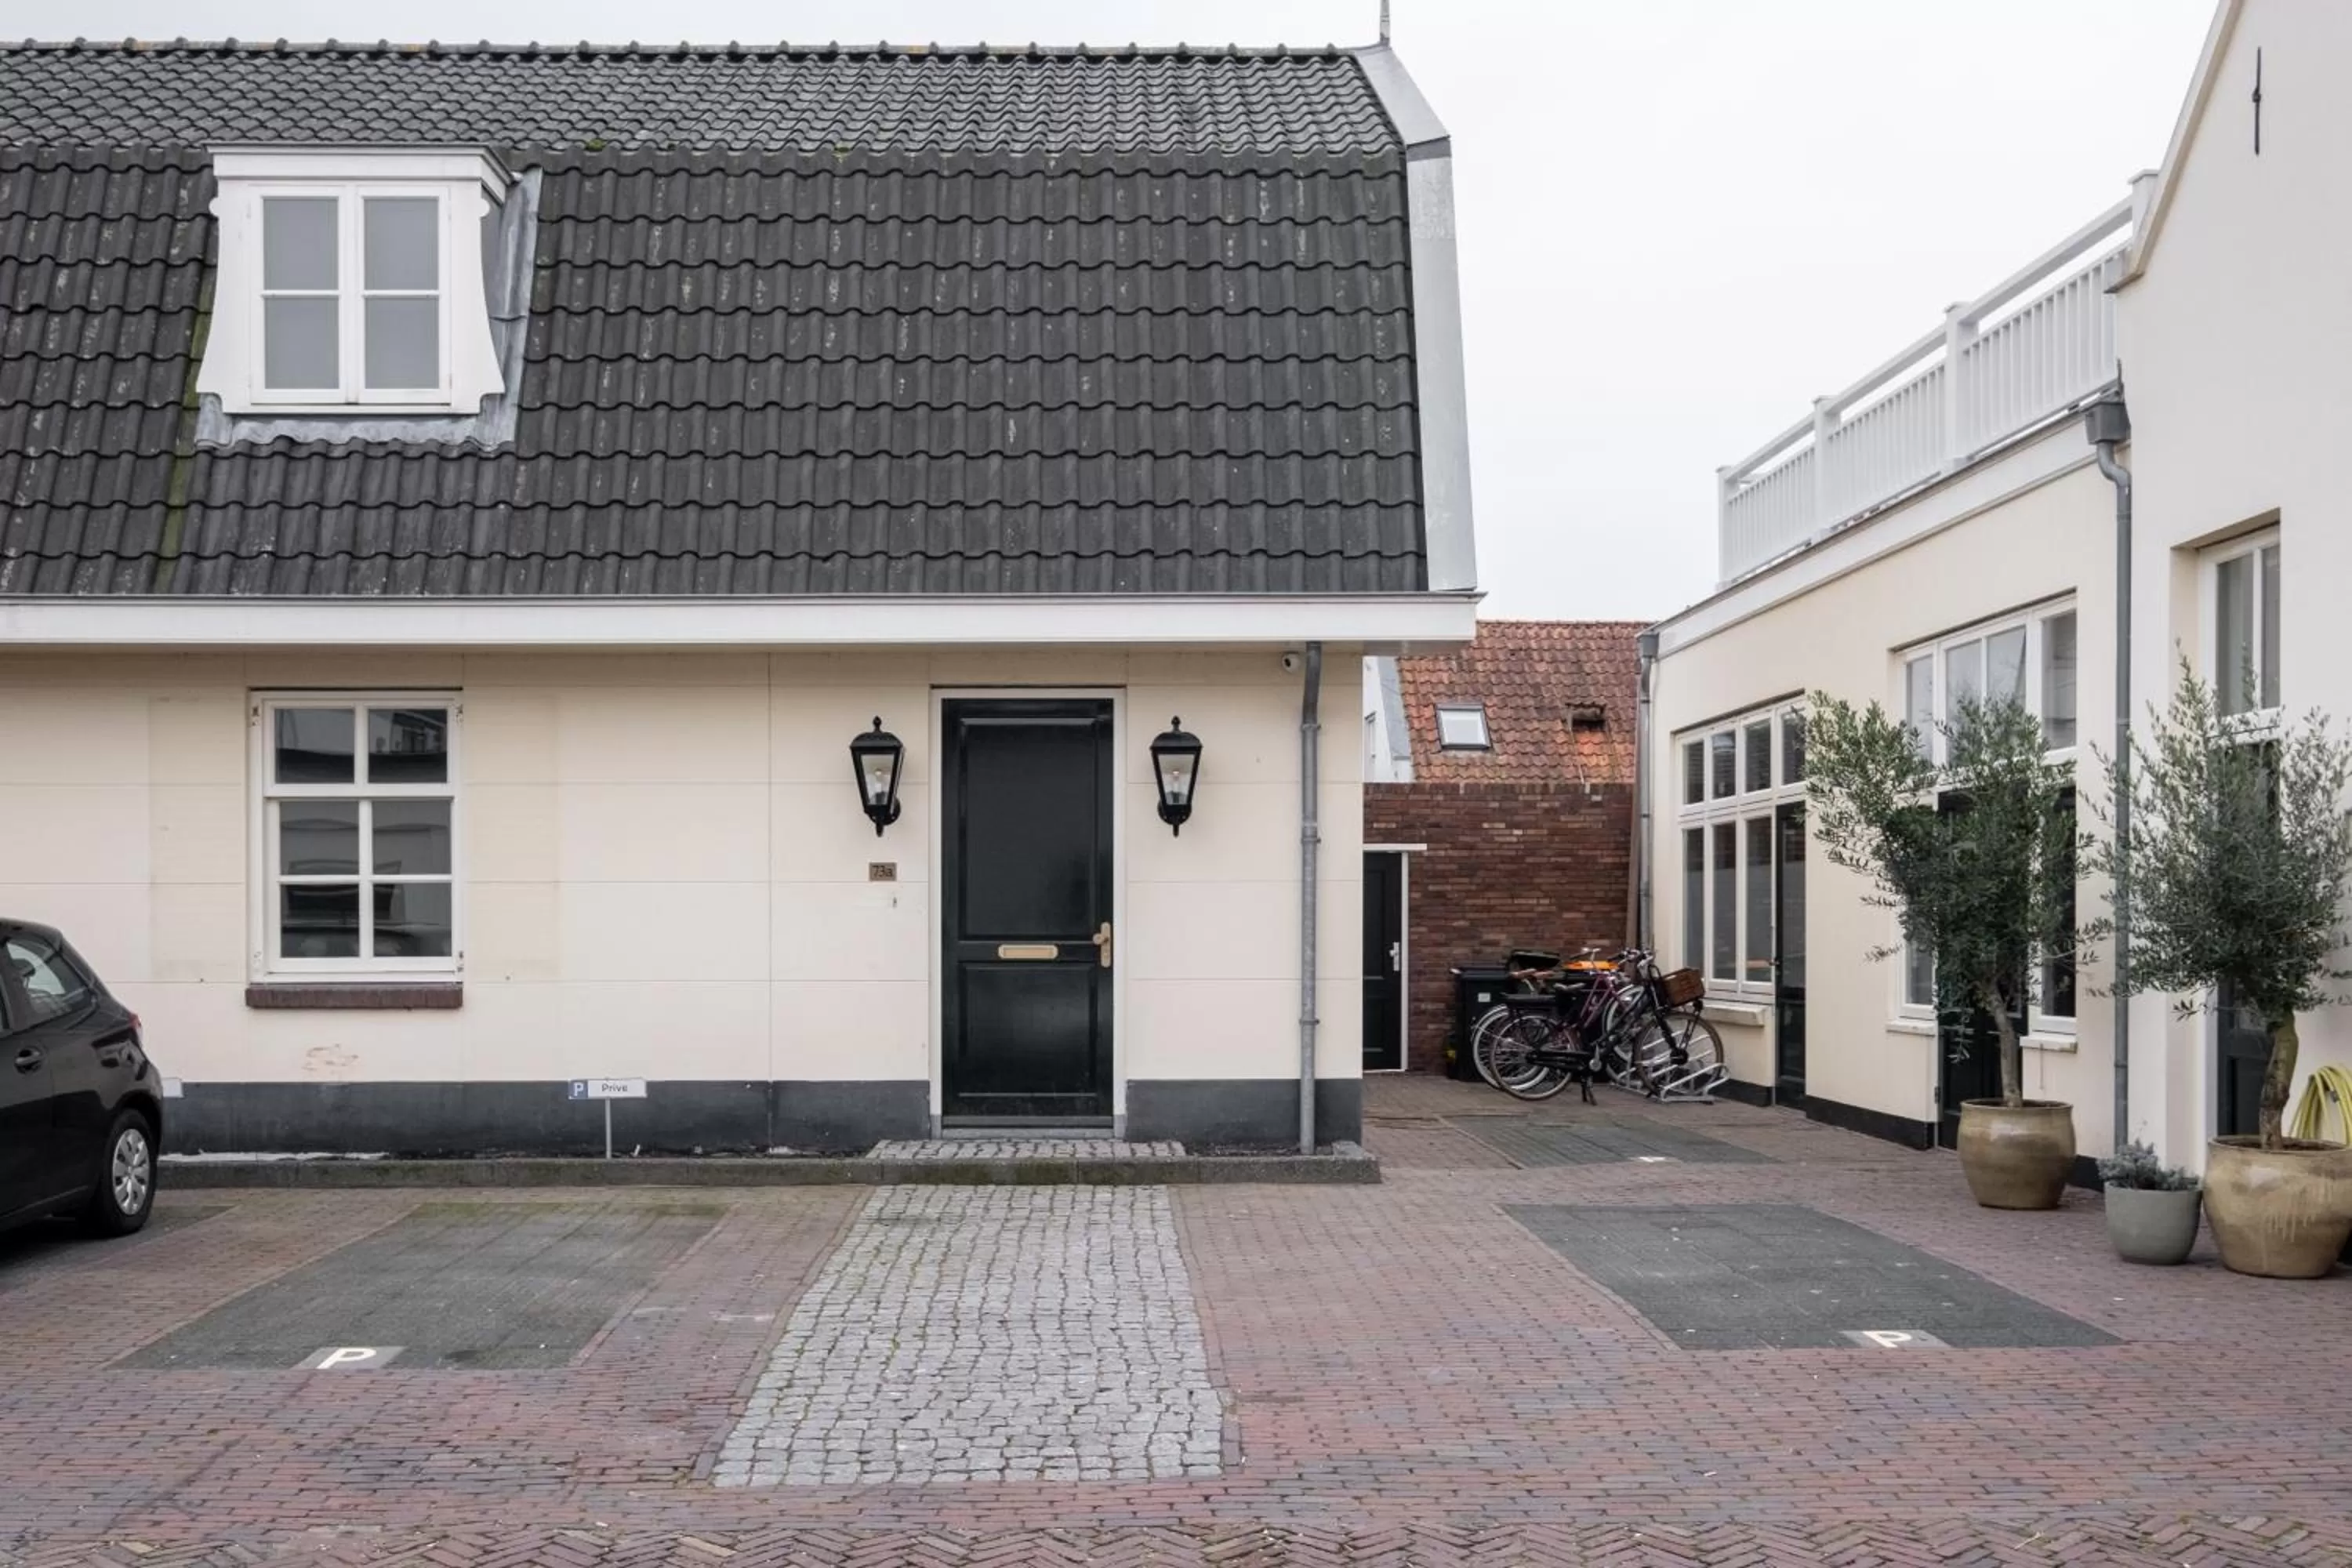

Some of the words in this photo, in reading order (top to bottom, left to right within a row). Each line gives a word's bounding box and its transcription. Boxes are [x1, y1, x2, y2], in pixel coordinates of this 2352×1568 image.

[872, 865, 892, 877] 73a
[574, 1083, 584, 1096] P
[1862, 1330, 1911, 1348] P
[316, 1348, 376, 1369] P
